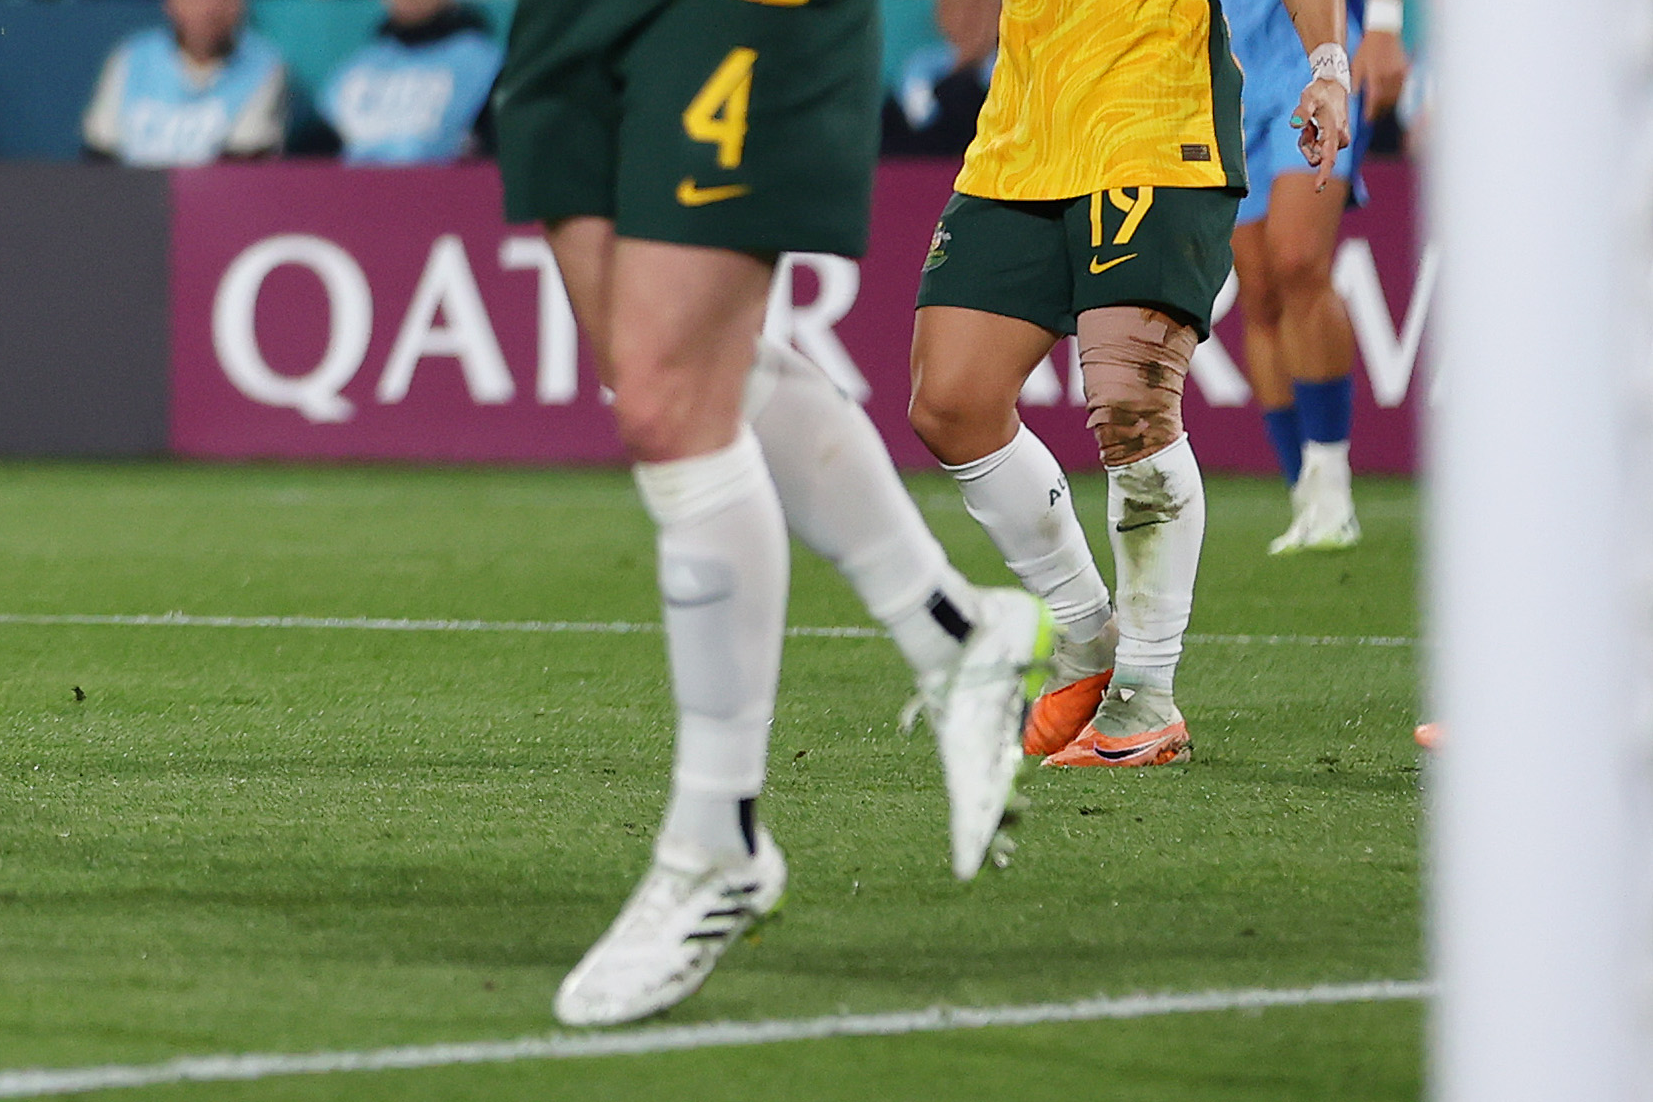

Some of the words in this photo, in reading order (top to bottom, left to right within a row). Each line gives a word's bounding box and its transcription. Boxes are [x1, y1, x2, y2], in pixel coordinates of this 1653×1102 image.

[682, 47, 758, 169] 4
[1089, 185, 1154, 248] 19
[212, 233, 872, 424] QATR
